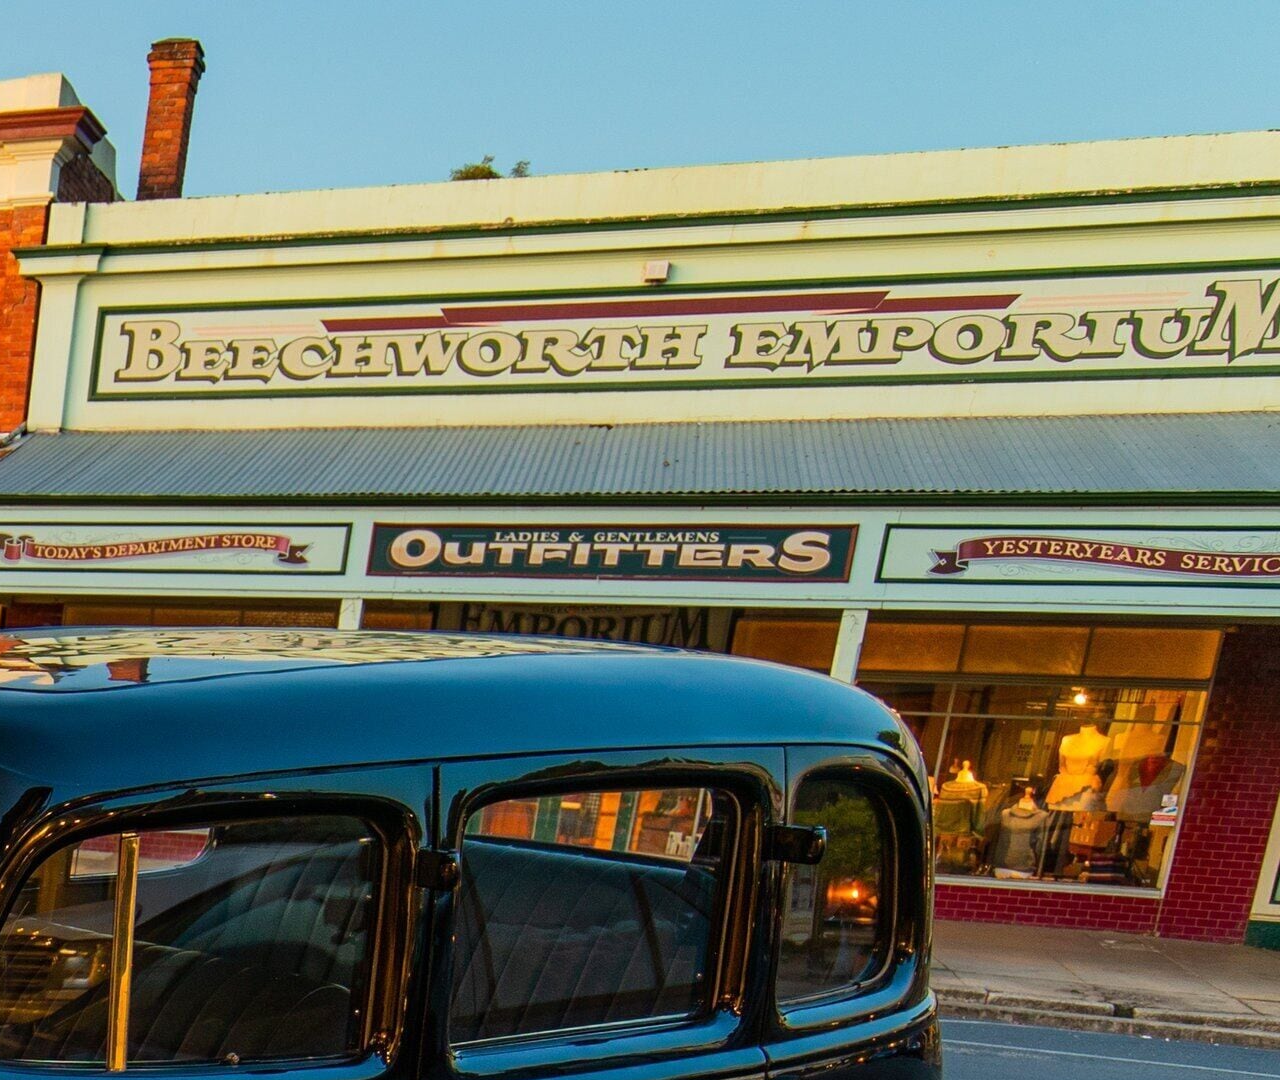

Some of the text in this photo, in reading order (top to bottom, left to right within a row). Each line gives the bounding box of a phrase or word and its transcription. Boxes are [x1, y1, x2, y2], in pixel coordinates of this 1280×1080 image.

[114, 278, 1280, 385] BEECHWORTH EMPORIUM
[34, 534, 277, 560] TODAY'S DEPARTMENT STORE
[494, 531, 720, 544] LADIES & GENTLEMENS
[983, 539, 1167, 567] YESTERYEARS
